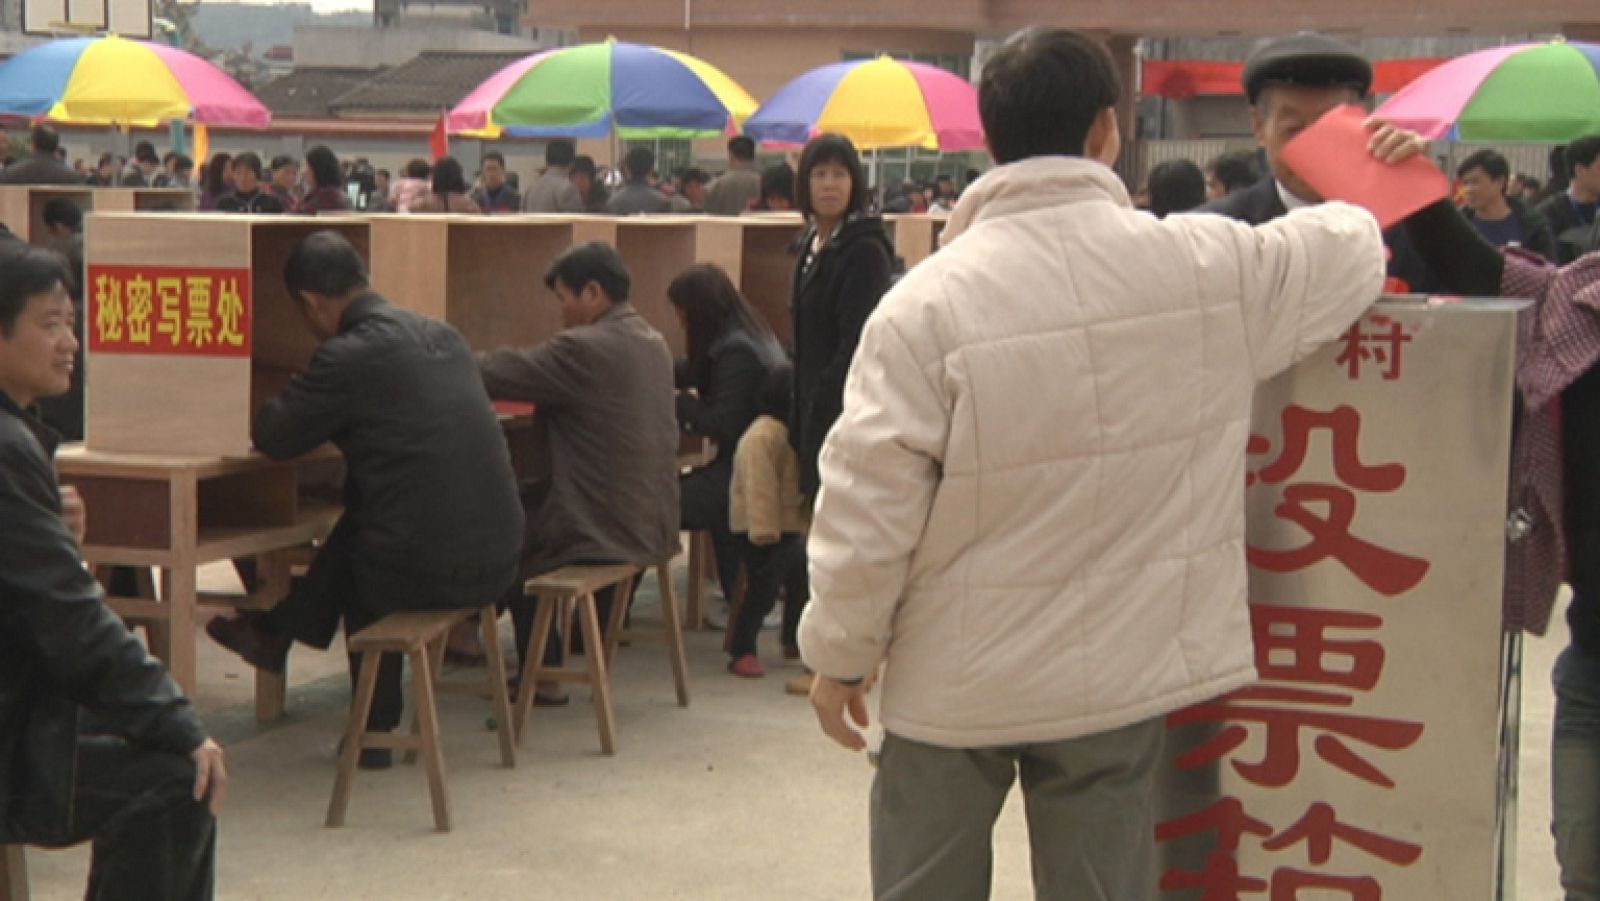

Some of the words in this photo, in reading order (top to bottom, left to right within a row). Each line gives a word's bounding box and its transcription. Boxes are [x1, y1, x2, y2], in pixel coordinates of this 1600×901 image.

[96, 273, 245, 347] 秘密写票处
[1336, 320, 1413, 380] 村
